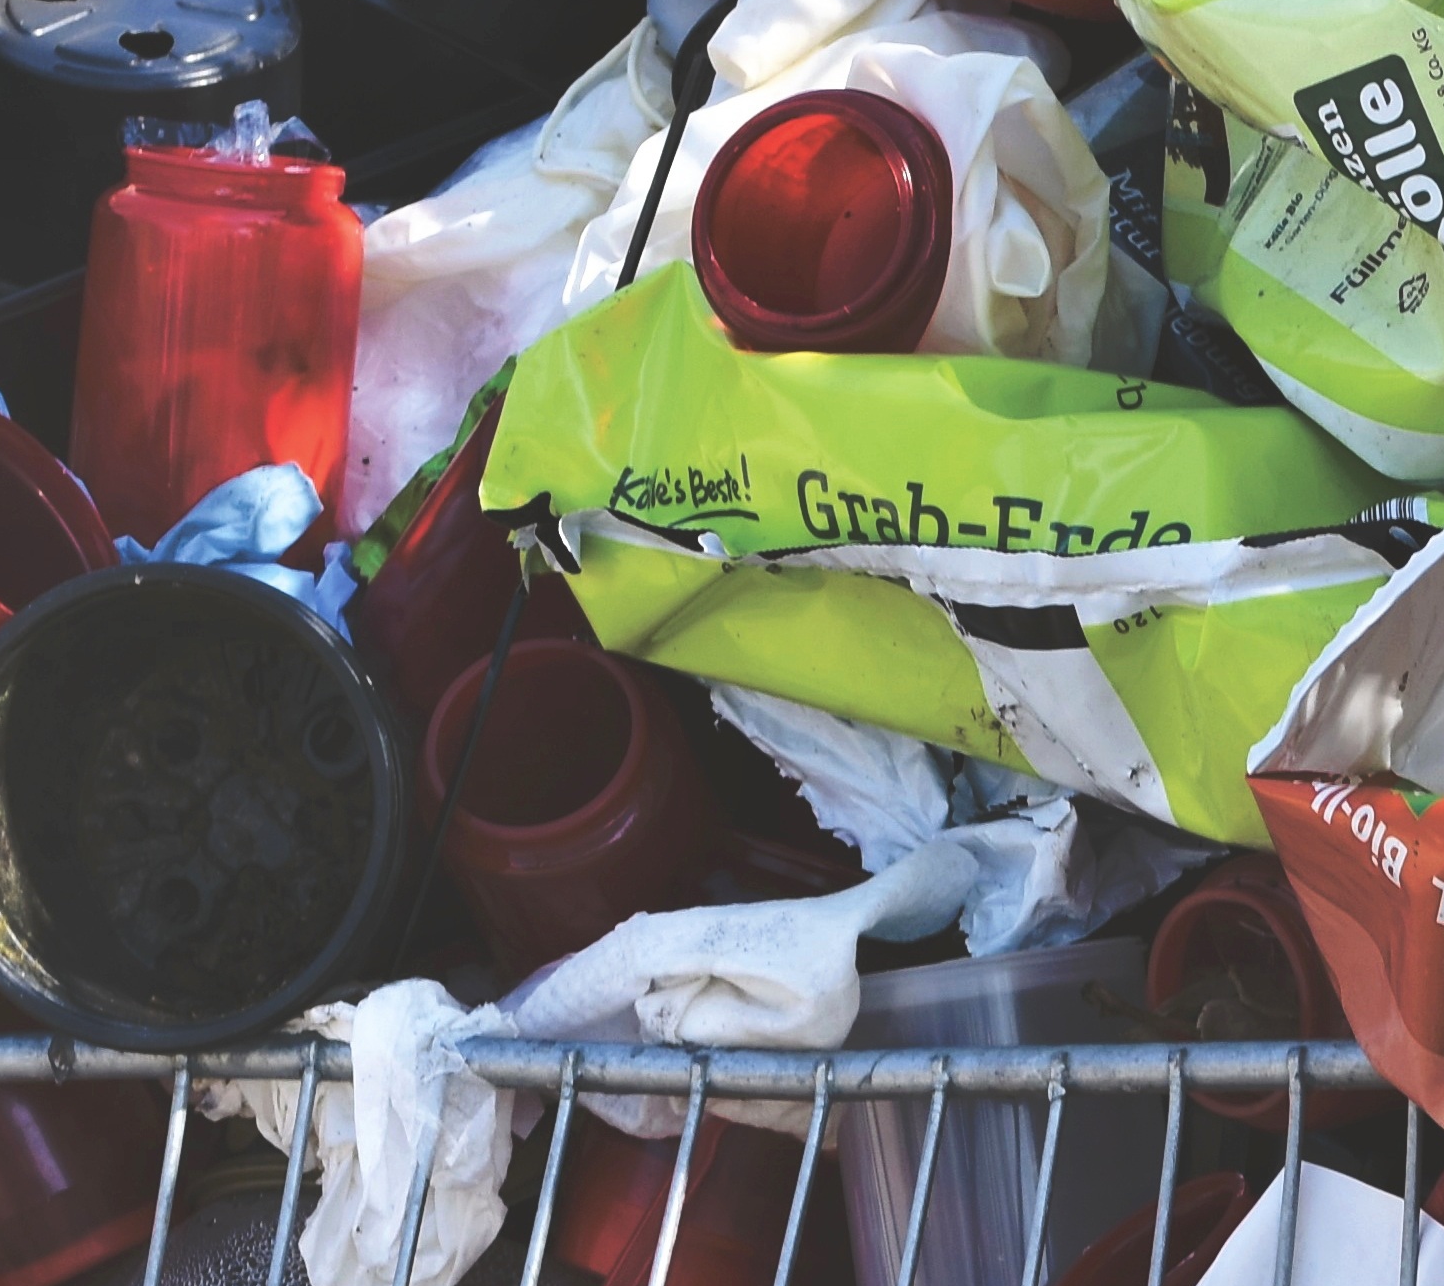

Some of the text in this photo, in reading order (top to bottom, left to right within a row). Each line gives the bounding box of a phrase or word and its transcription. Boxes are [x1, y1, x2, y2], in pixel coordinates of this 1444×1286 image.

[1411, 27, 1432, 53] KG
[1423, 53, 1444, 81] Co.
[692, 452, 751, 503] Beste!
